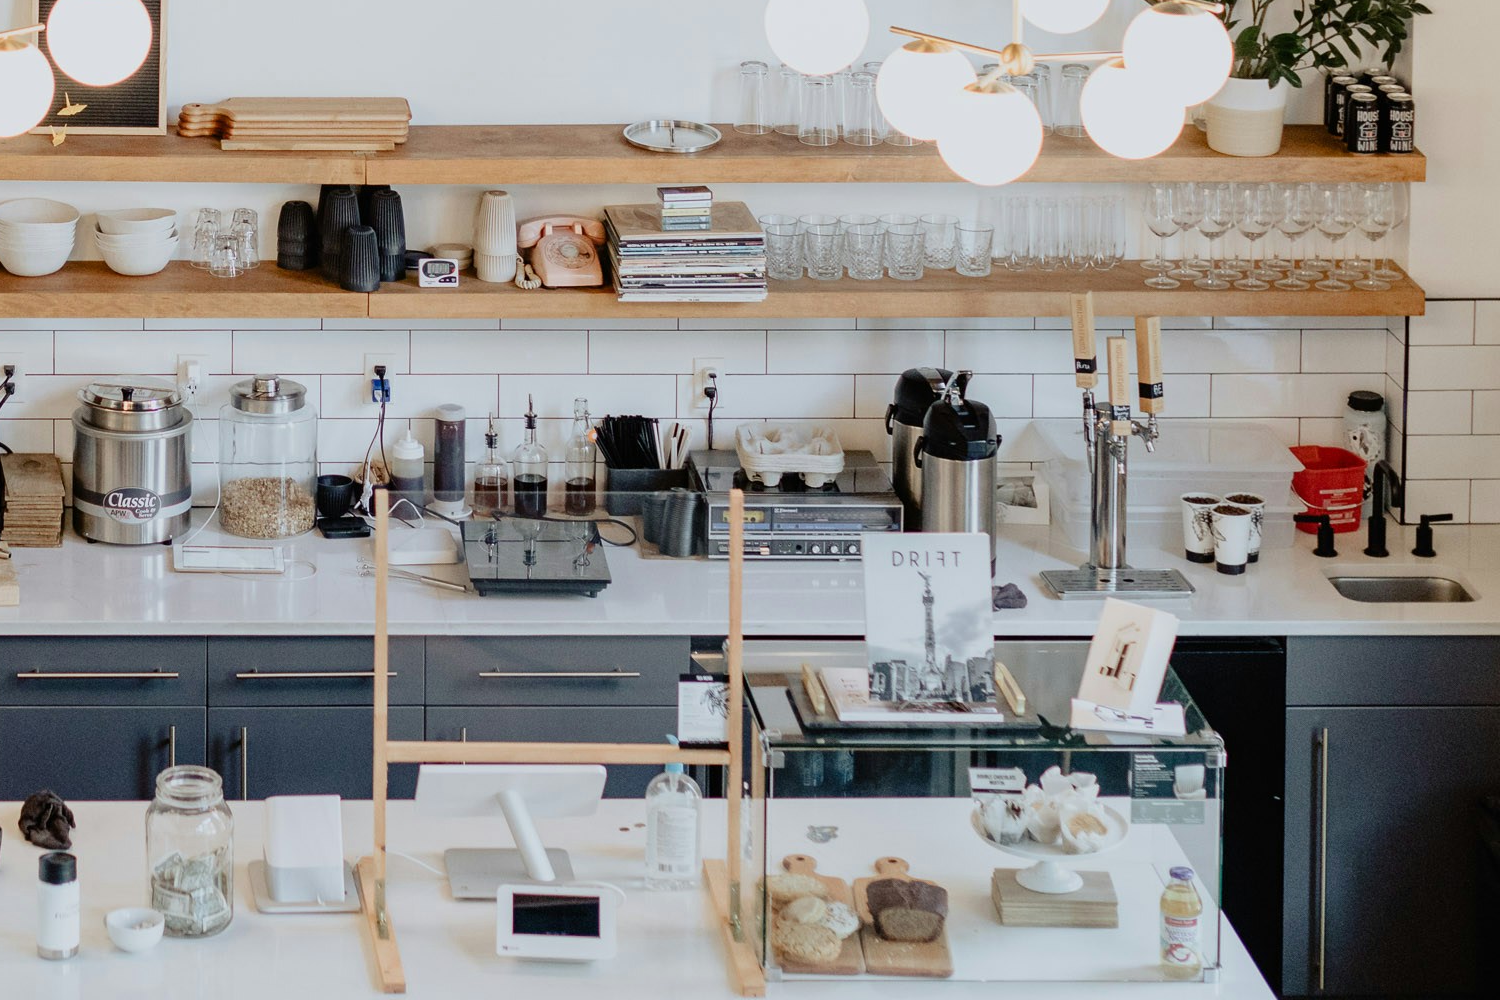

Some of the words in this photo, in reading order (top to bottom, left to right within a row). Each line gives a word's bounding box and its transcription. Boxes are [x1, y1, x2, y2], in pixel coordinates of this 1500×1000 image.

[1389, 109, 1414, 122] HOUSE
[1389, 140, 1413, 151] WINE
[108, 492, 157, 508] Classic
[891, 550, 962, 568] DRIFT
